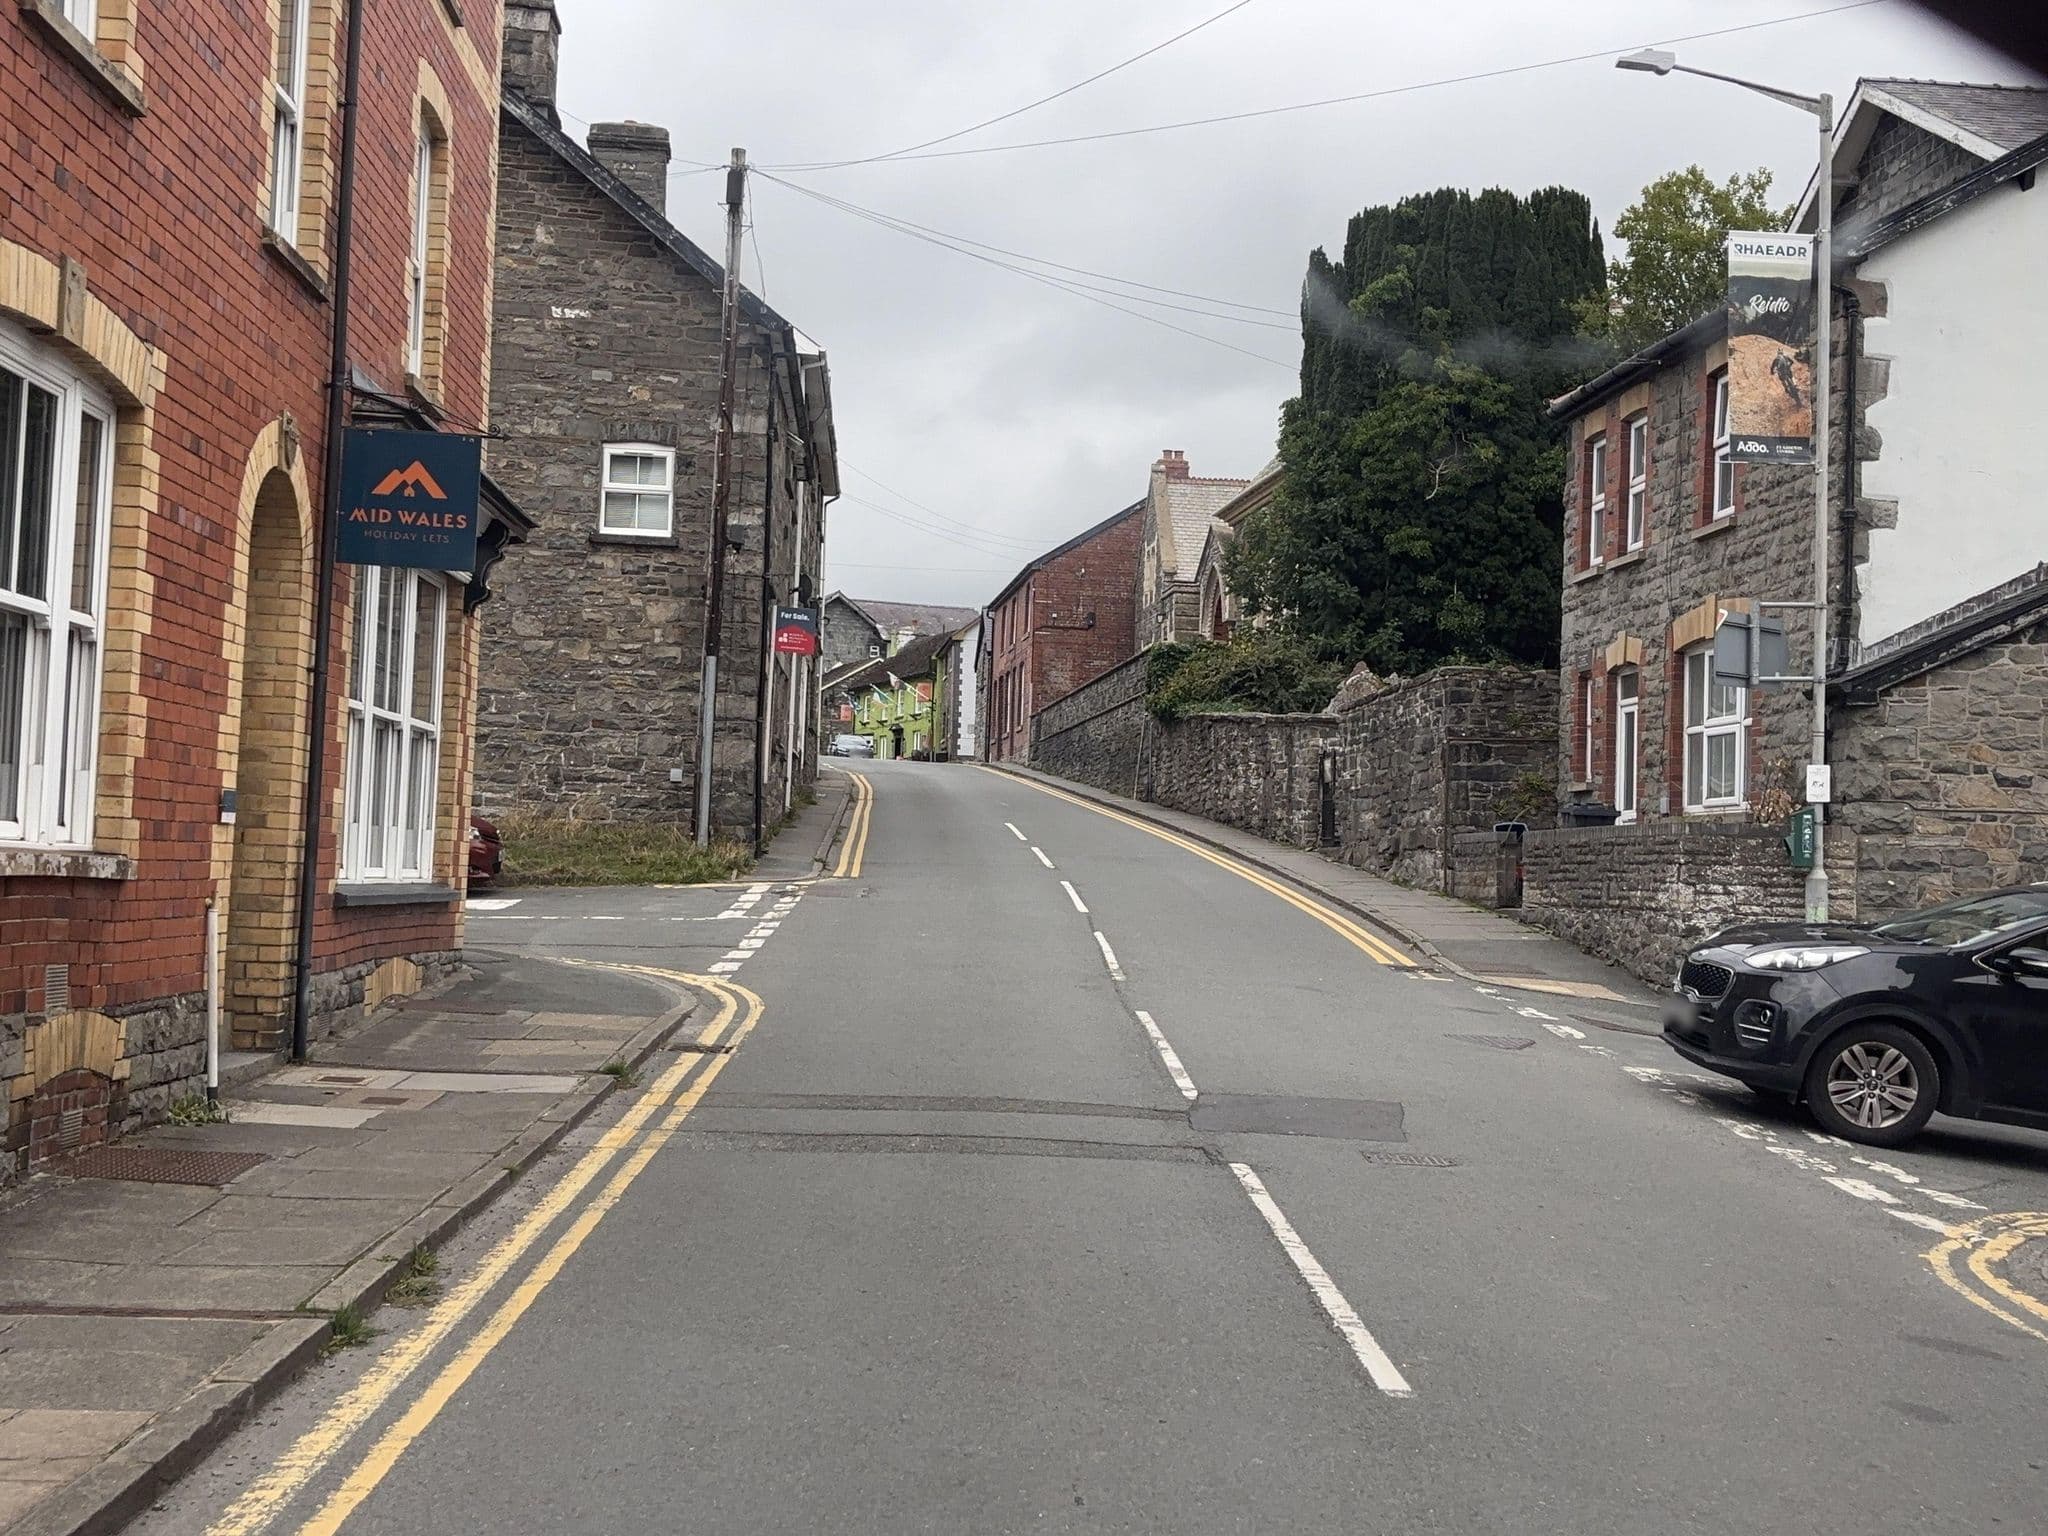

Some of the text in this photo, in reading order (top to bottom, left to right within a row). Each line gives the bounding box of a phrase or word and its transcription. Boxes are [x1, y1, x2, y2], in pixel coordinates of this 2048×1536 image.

[1734, 243, 1808, 257] RHAEADR
[1749, 294, 1790, 314] Reidio
[348, 507, 468, 529] MID WALES
[363, 529, 449, 544] HOLIDAY LETS
[781, 611, 792, 619] For
